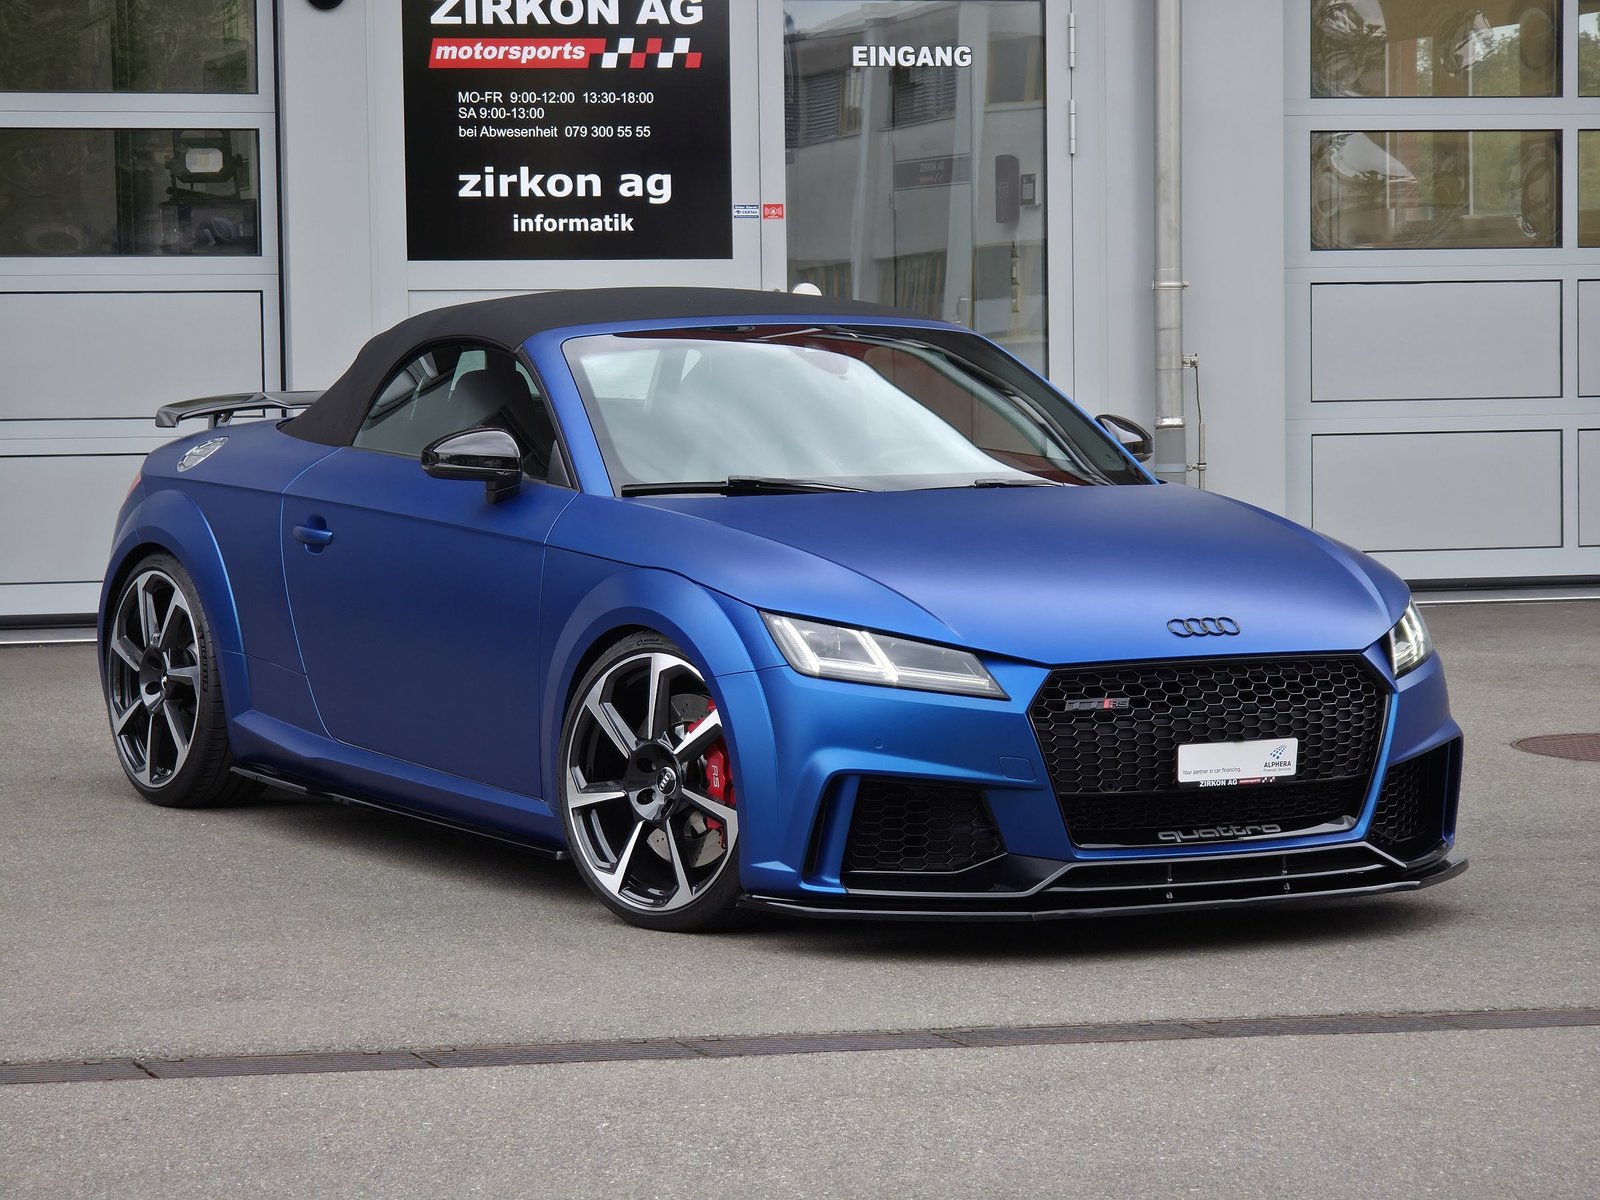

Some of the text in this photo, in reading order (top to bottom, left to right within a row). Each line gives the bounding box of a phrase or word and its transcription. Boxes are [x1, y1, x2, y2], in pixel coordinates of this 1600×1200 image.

[430, 0, 704, 25] ZIRKON AG
[435, 41, 586, 64] motorsports
[852, 45, 972, 67] EINGANG
[457, 91, 654, 104] MO-FR 9:00-12:00 13:30-18:00
[458, 107, 545, 119] SA 9:00-13:00
[458, 125, 651, 138] bei Abwesenheit 079 300 55 55
[458, 166, 672, 205] zirkon ag
[513, 213, 635, 233] informatik
[1263, 760, 1292, 768] ALPHERA
[1199, 779, 1227, 788] ZIRKON
[1227, 778, 1238, 786] AG
[1158, 823, 1281, 842] quattro
